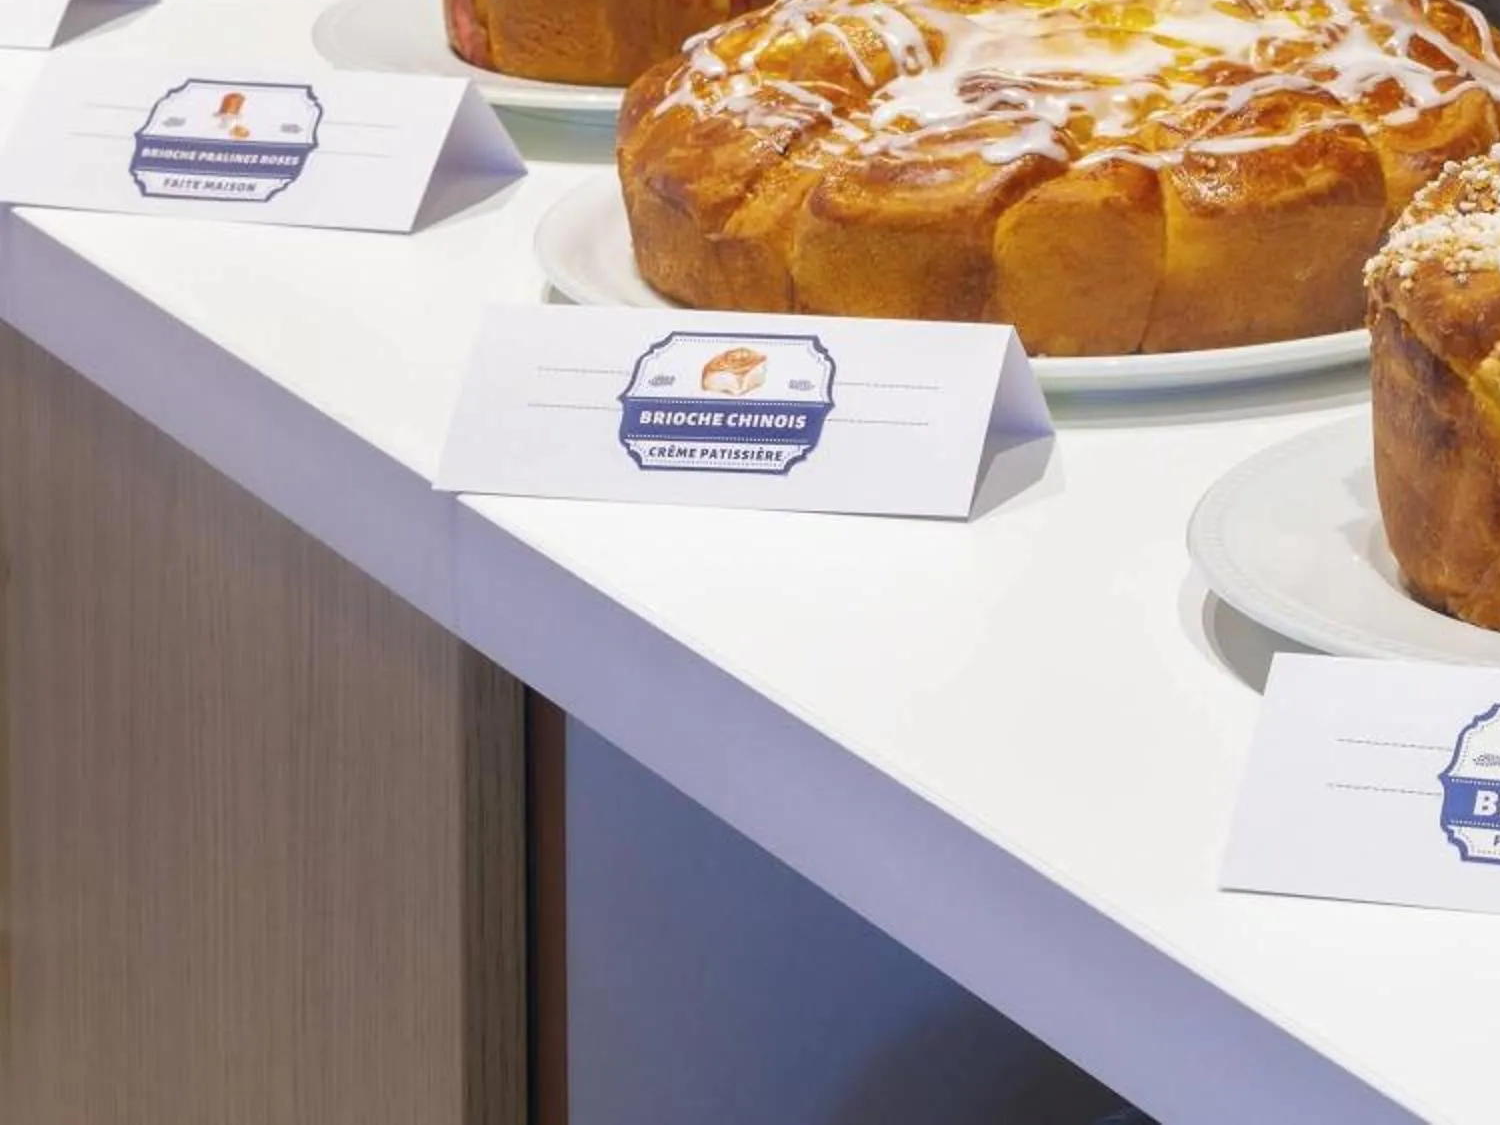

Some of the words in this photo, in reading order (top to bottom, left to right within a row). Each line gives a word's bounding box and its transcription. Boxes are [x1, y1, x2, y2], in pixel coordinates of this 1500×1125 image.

[141, 146, 196, 161] BRIOCHE
[198, 150, 258, 165] PRALINES
[259, 153, 300, 166] ROSES
[163, 178, 201, 191] FAITE
[204, 180, 257, 193] MAISON
[639, 410, 726, 427] BRIOCHE
[727, 413, 807, 429] CHINOIS
